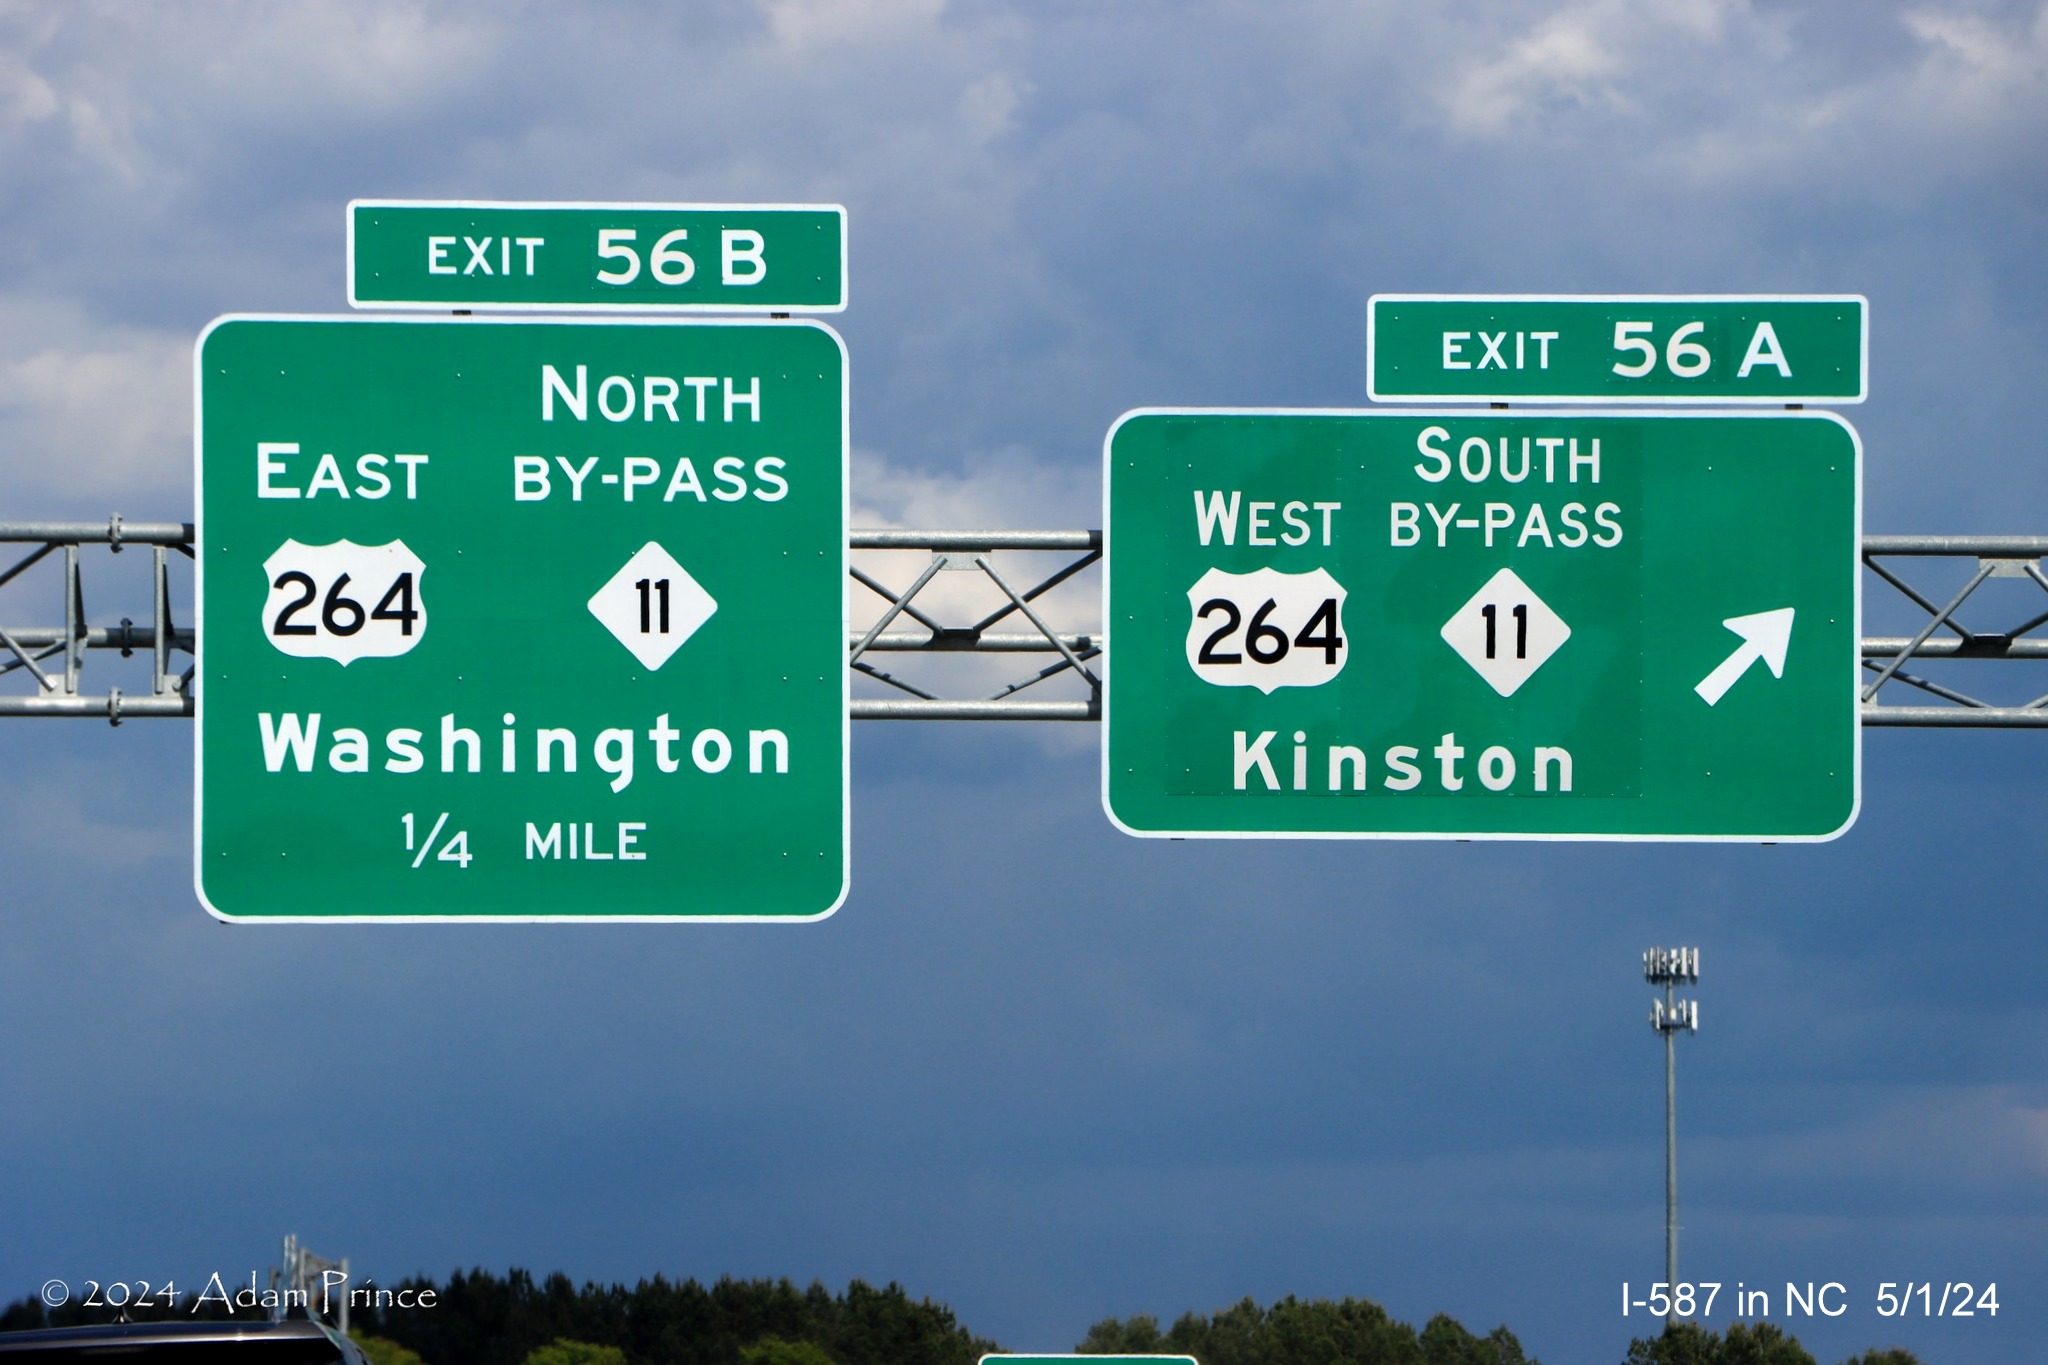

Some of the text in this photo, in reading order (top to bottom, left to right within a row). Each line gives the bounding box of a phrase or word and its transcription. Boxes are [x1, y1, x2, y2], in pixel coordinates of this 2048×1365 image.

[428, 229, 767, 285] EXIT 56 B
[1442, 321, 1793, 378] EXIT 56 A
[541, 365, 761, 422] NORTH
[257, 443, 429, 499] EAST
[514, 456, 789, 502] BY-PASS
[1414, 426, 1602, 484] SOUTH
[1194, 490, 1342, 547] WEST
[1390, 502, 1623, 548] BY-PASS
[272, 571, 419, 637] 264
[635, 579, 671, 634] 11
[1197, 599, 1343, 665] 264
[1481, 604, 1528, 660] 11
[258, 712, 790, 793] Washington
[1233, 731, 1573, 792] Kinston
[526, 822, 647, 861] MILE
